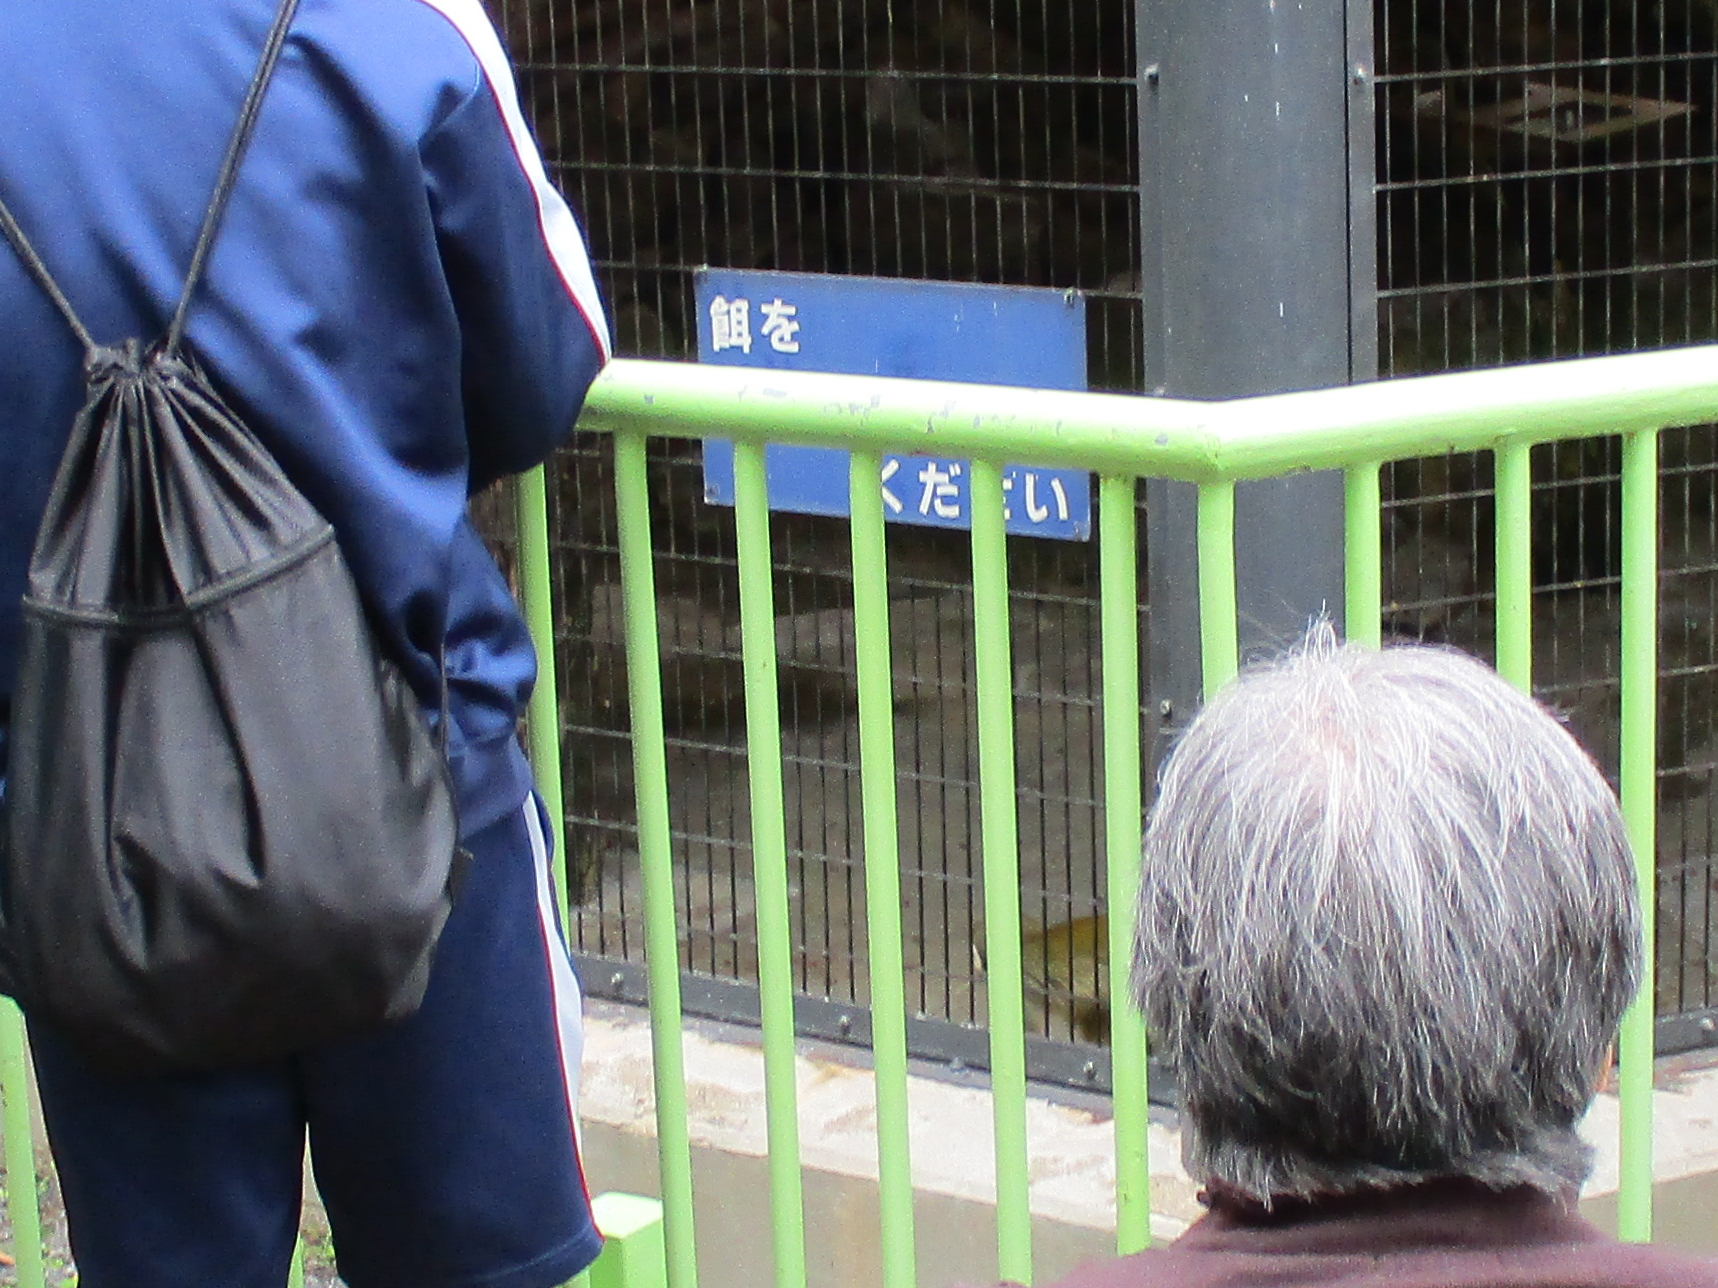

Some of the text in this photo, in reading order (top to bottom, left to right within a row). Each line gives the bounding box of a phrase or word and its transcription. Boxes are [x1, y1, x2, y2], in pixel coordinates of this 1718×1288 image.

[710, 295, 801, 354] 餌を
[880, 458, 1069, 523] くだい
